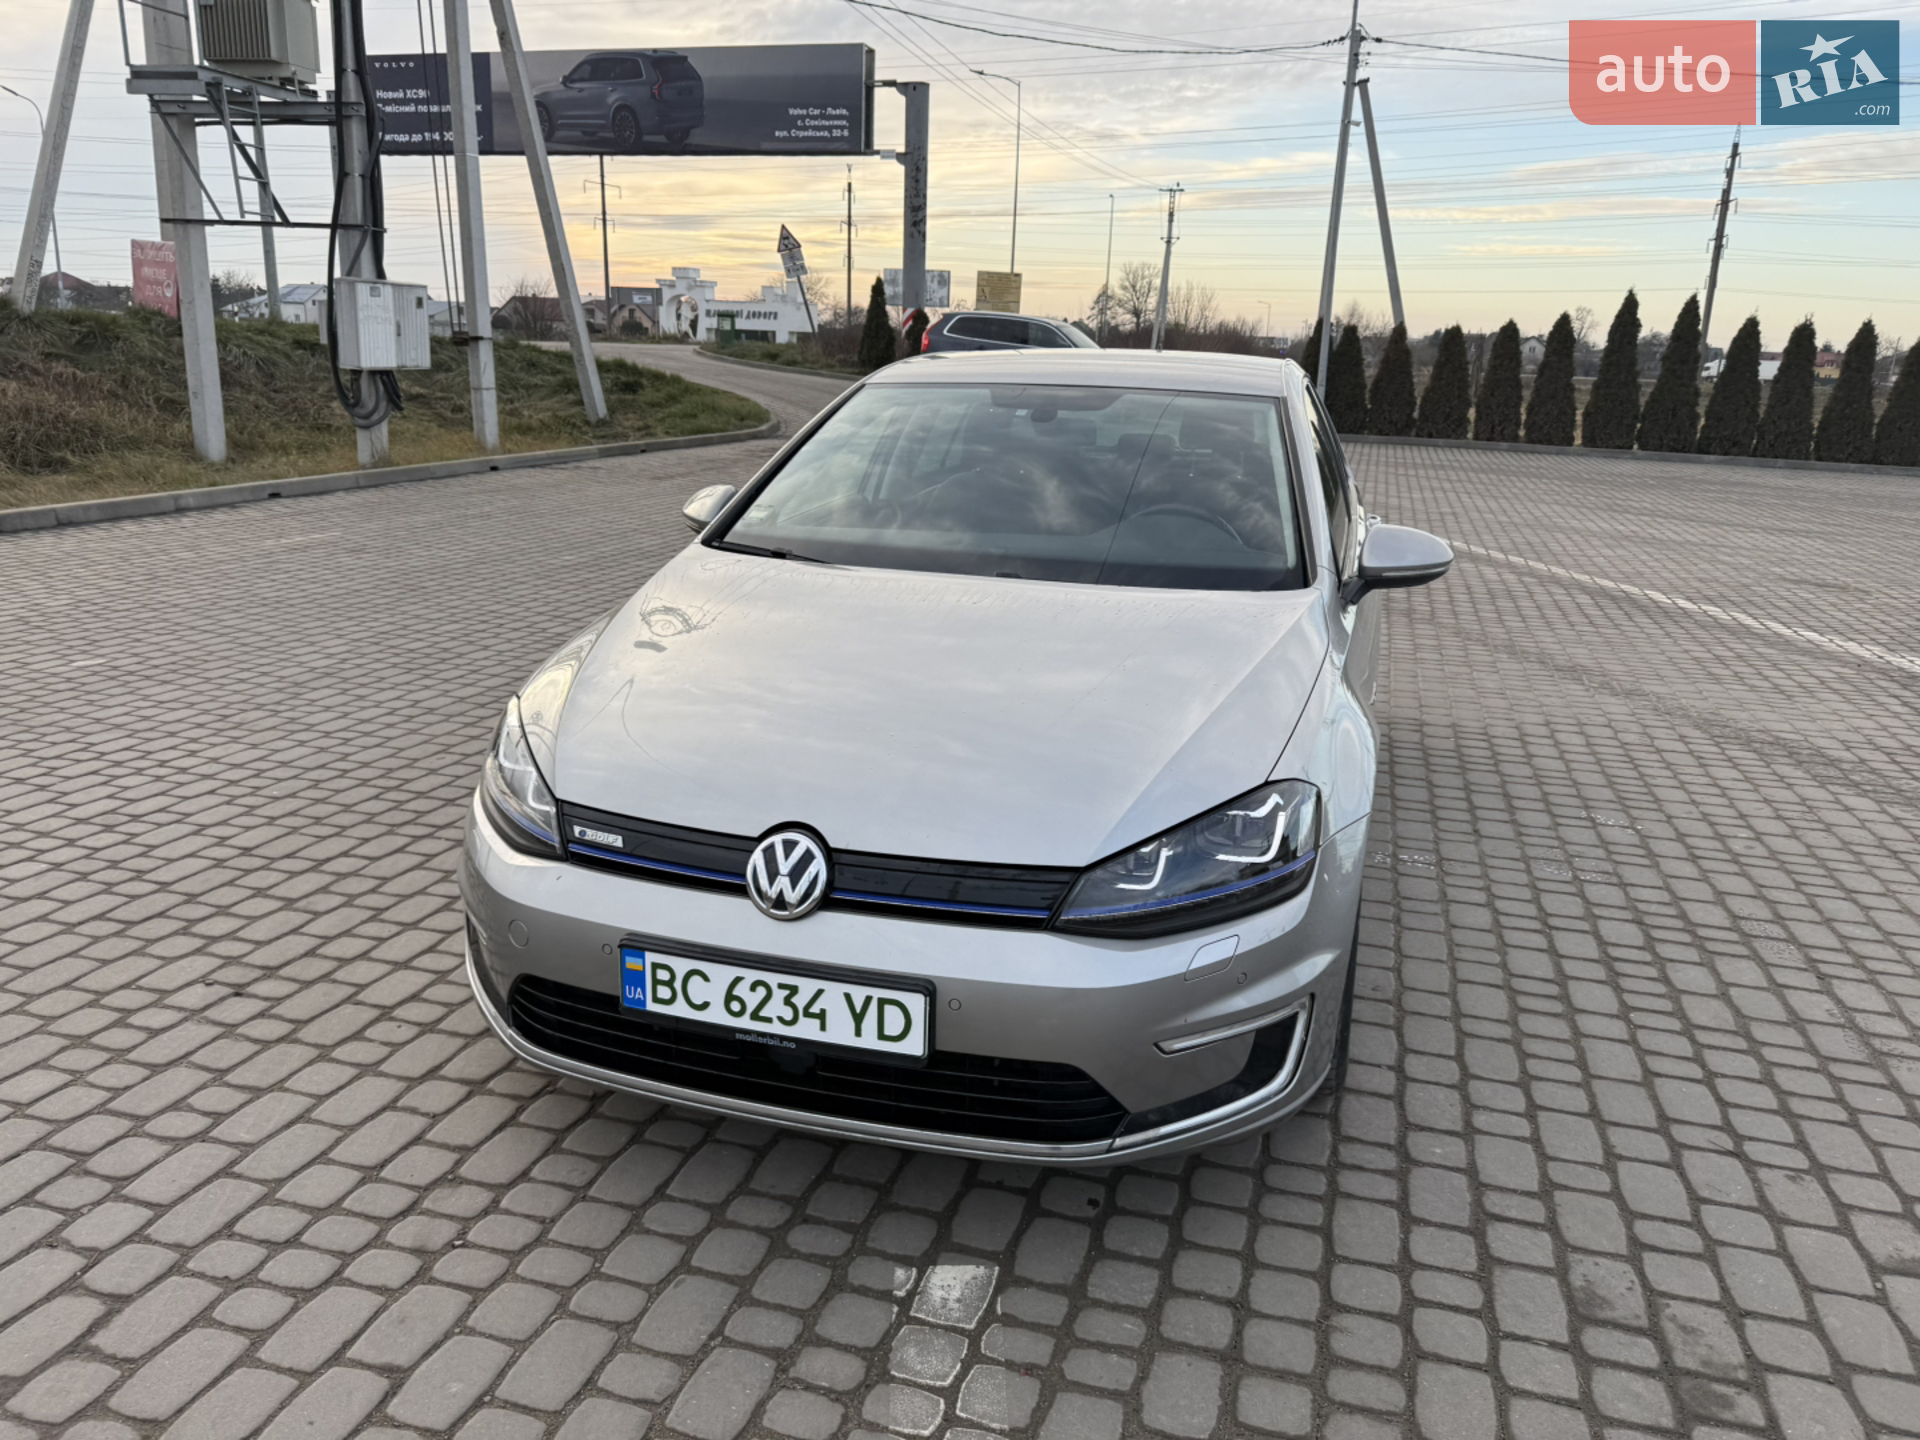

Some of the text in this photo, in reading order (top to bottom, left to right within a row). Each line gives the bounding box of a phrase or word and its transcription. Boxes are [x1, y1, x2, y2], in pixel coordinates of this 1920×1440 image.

[376, 89, 404, 99] Новий
[808, 107, 821, 116] Car
[826, 107, 849, 116] Львів,
[411, 133, 423, 143] до
[774, 130, 789, 138] вул.
[626, 985, 644, 1001] UA
[650, 961, 913, 1043] BC 6234 YD
